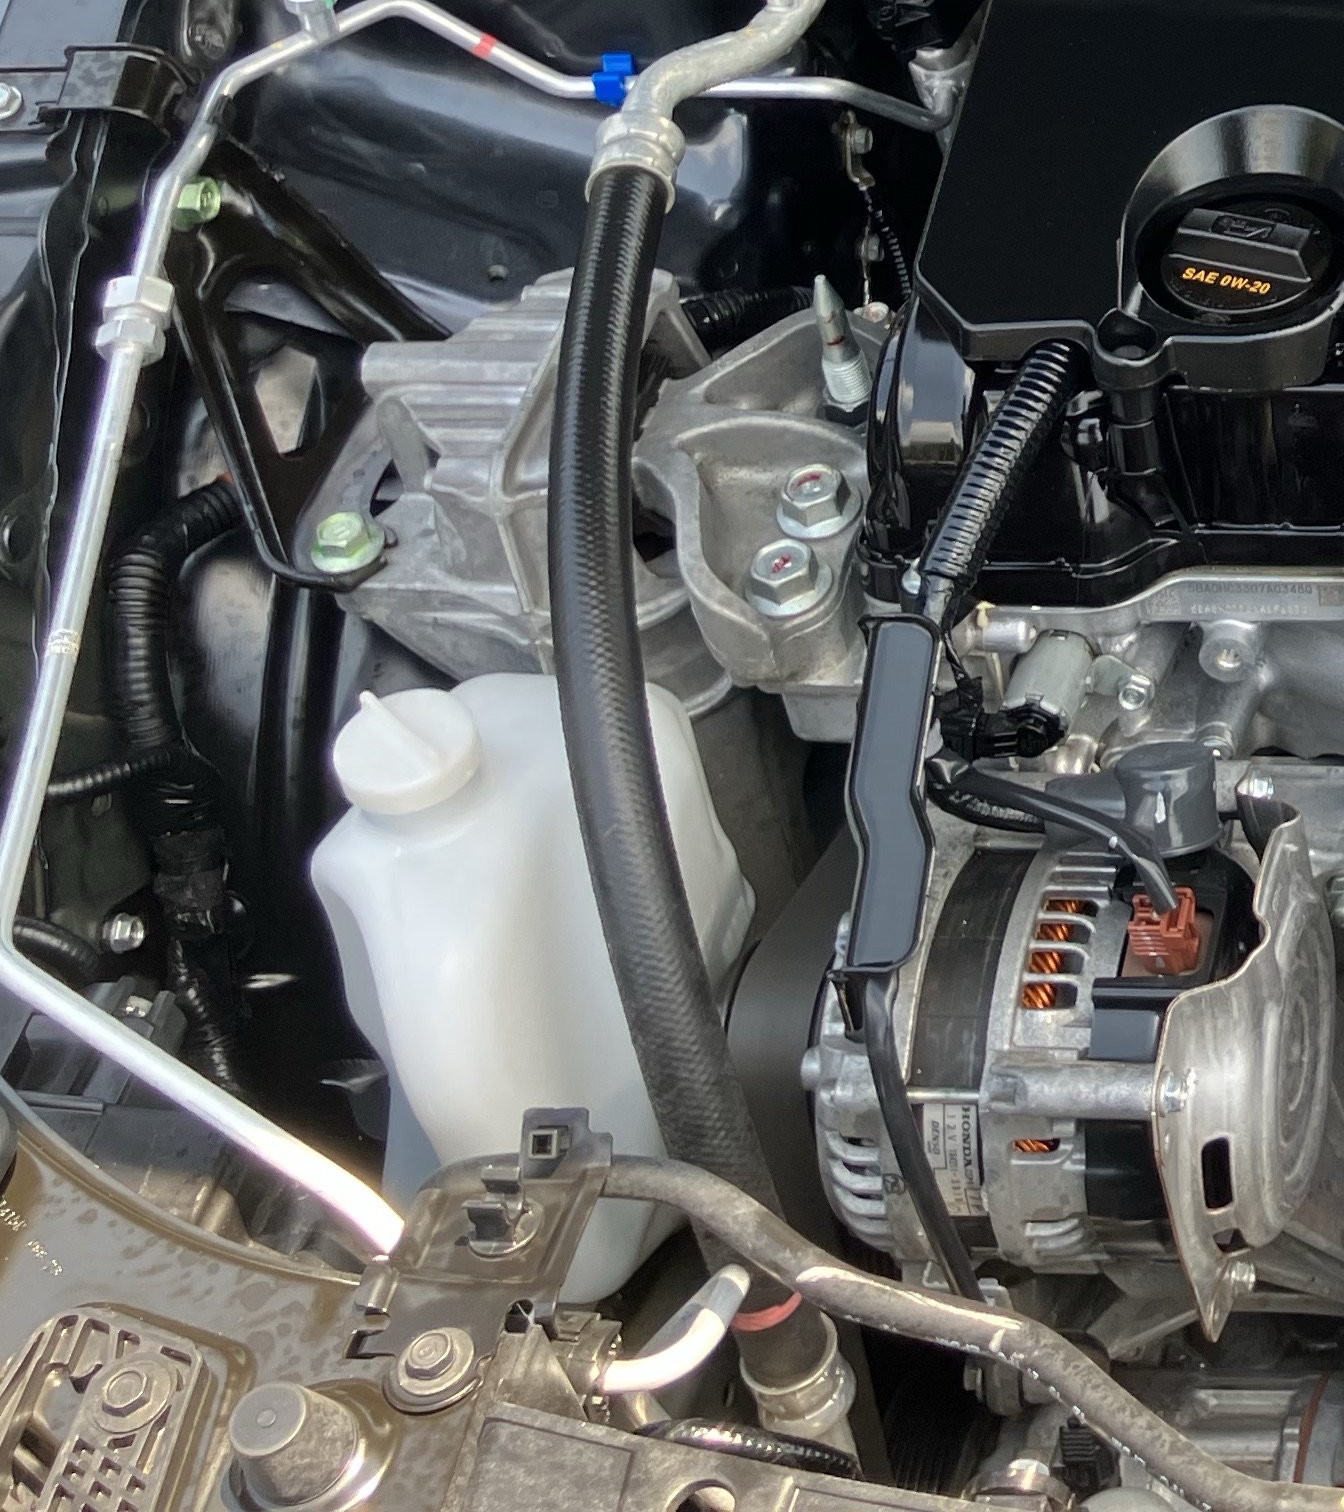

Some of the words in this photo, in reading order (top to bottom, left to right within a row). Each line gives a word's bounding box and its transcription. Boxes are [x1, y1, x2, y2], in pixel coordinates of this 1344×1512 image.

[1181, 267, 1220, 285] SAE
[1220, 275, 1272, 295] 0W-20
[930, 1119, 941, 1155] DENSO
[961, 1106, 973, 1168] HONDA
